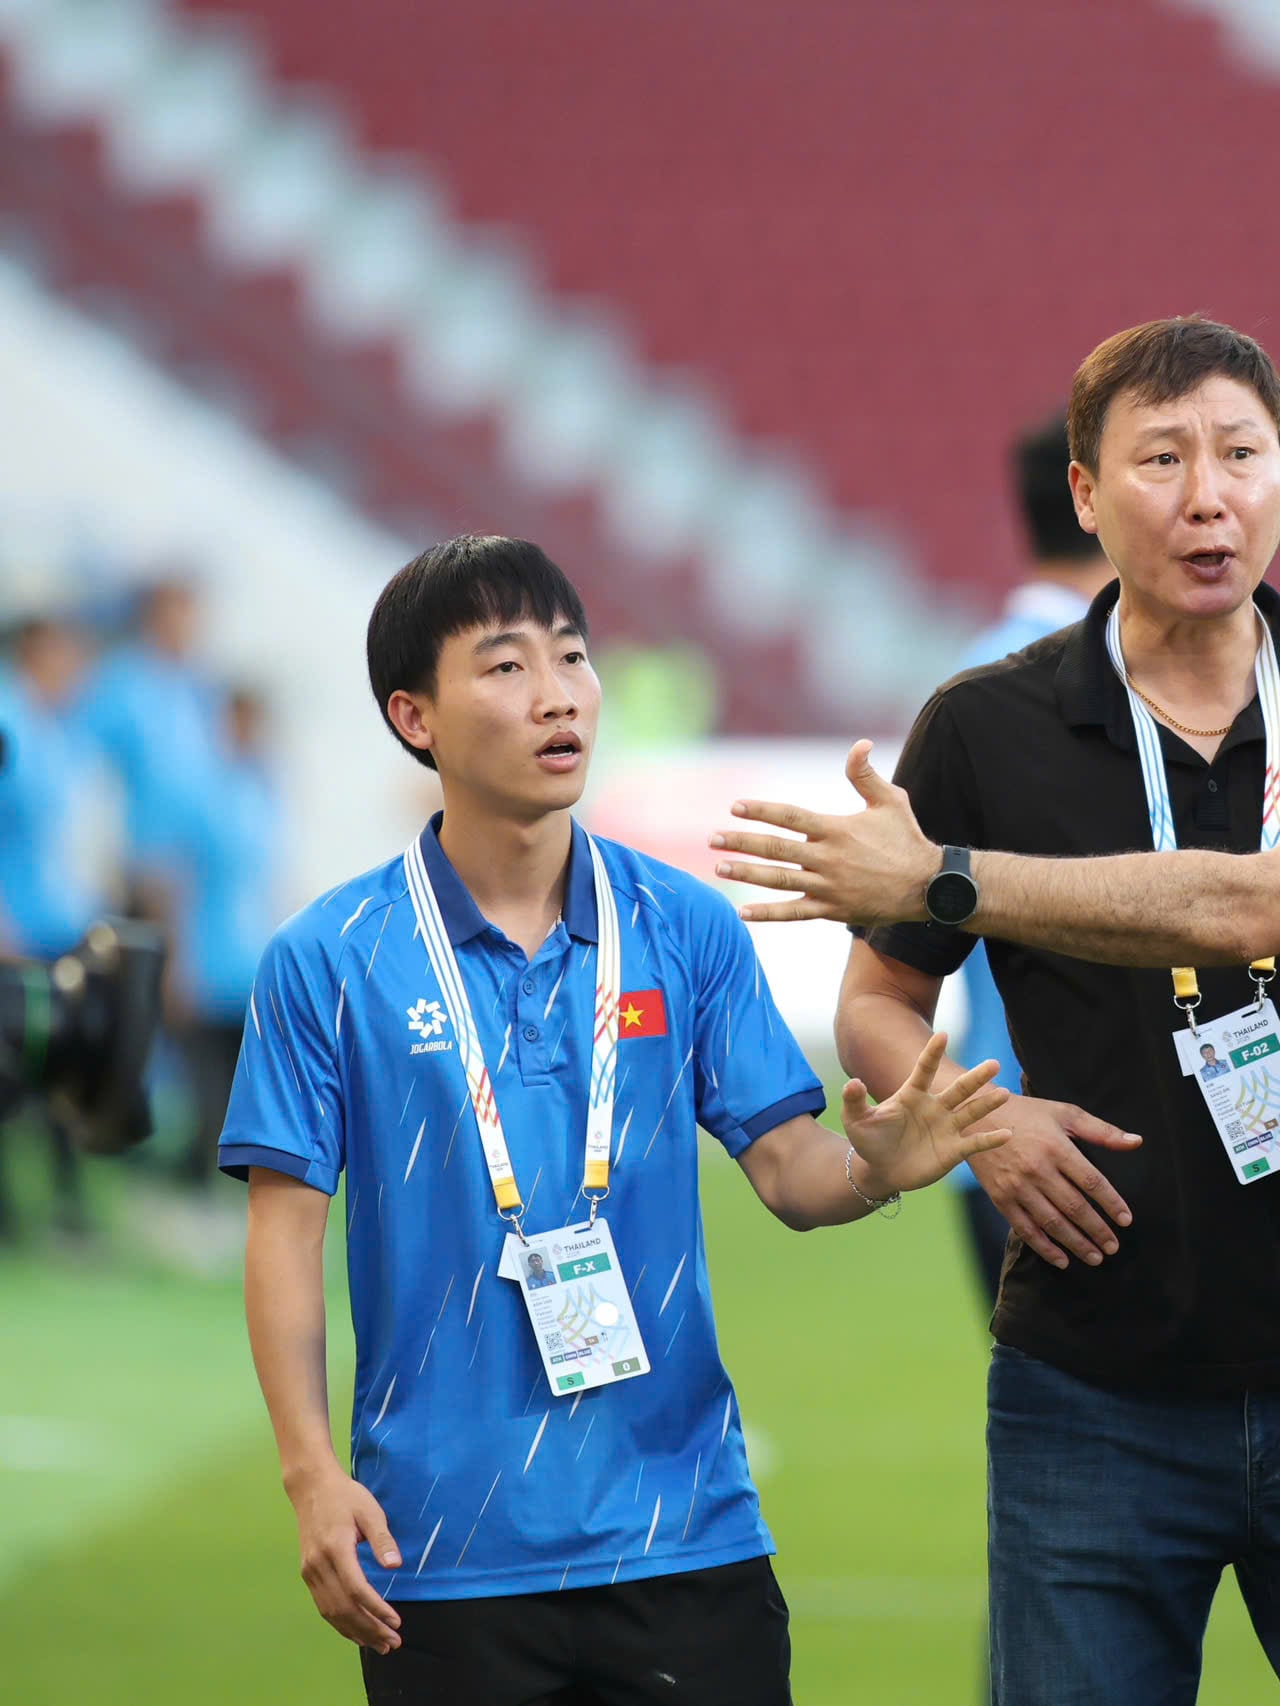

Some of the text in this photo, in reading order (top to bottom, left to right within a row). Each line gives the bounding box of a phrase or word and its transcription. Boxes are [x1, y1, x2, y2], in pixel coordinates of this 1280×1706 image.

[1233, 1019, 1269, 1039] THAILAND
[1241, 1042, 1270, 1061] F-02
[1252, 1163, 1260, 1173] S
[564, 1238, 601, 1252] THAILAND
[573, 1262, 596, 1275] F-X
[567, 1376, 575, 1386] S
